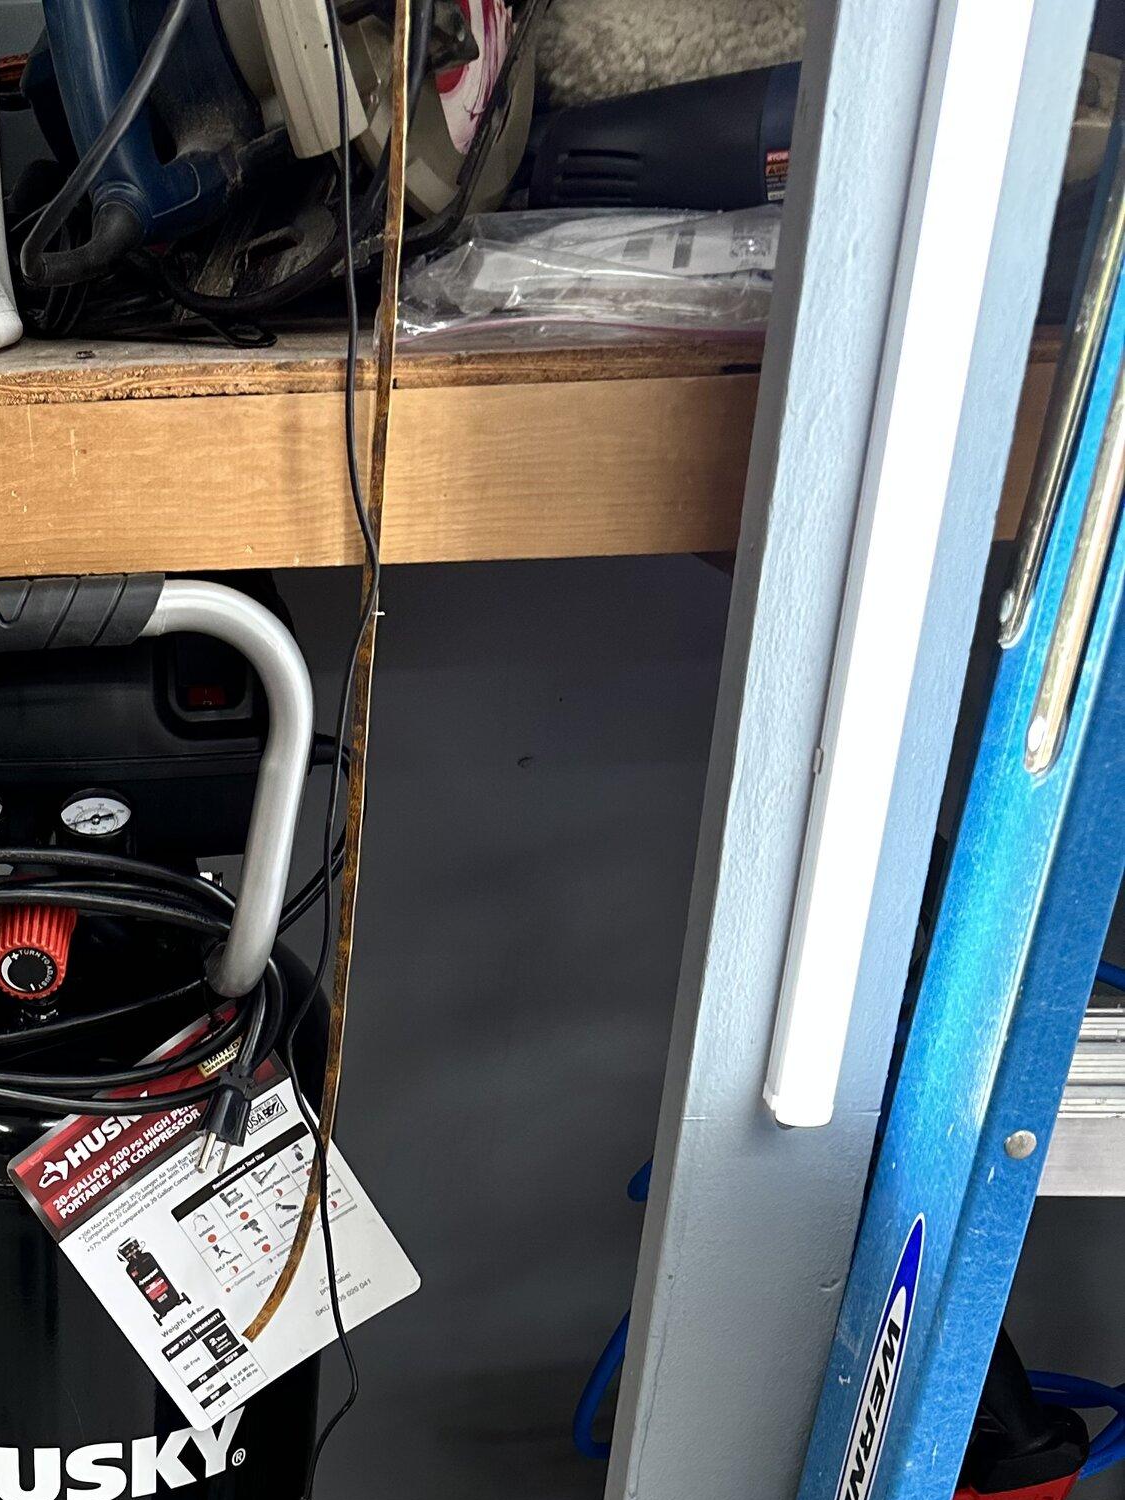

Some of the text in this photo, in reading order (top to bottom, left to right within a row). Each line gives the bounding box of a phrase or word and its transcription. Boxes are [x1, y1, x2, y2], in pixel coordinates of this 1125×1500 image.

[18, 949, 54, 990] TURN TO ADJUST
[205, 1050, 239, 1073] WARRANT
[53, 1116, 172, 1210] 20-GALLON 200 PSI HIGH
[59, 1176, 112, 1219] PORTABLE
[111, 1161, 132, 1180] AIR
[130, 1108, 201, 1164] COMPRESSOR
[208, 1336, 217, 1346] 2
